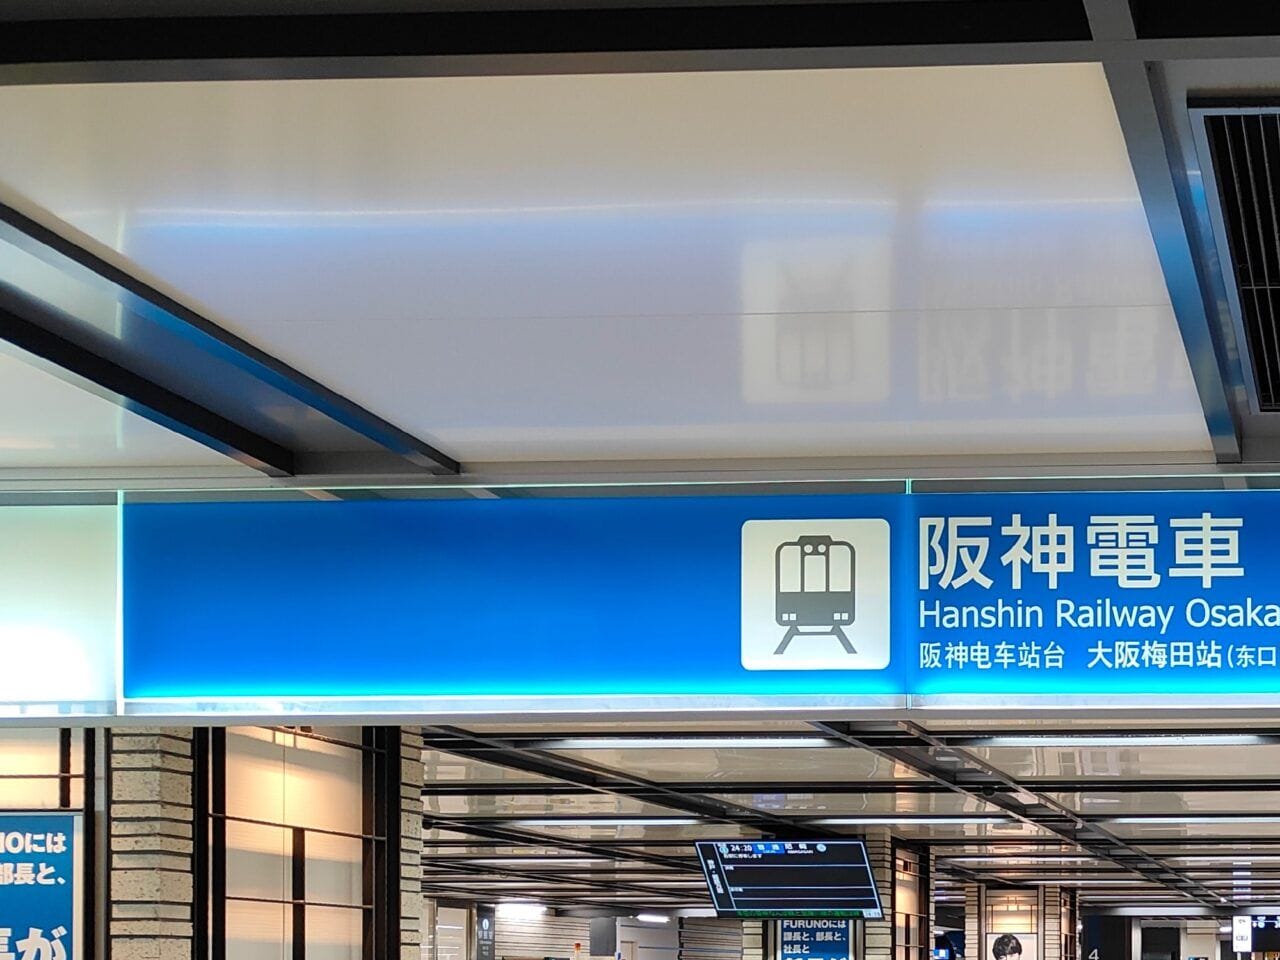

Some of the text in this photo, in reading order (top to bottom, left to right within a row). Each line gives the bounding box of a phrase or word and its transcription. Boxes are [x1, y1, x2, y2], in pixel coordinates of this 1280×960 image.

[919, 512, 1245, 590] 阪神電車
[919, 598, 1043, 629] Hanshin
[1056, 598, 1174, 635] Railway
[919, 641, 1065, 669] 阪神电车站台
[783, 919, 847, 929] FURUNOには
[783, 944, 811, 954] 社長と
